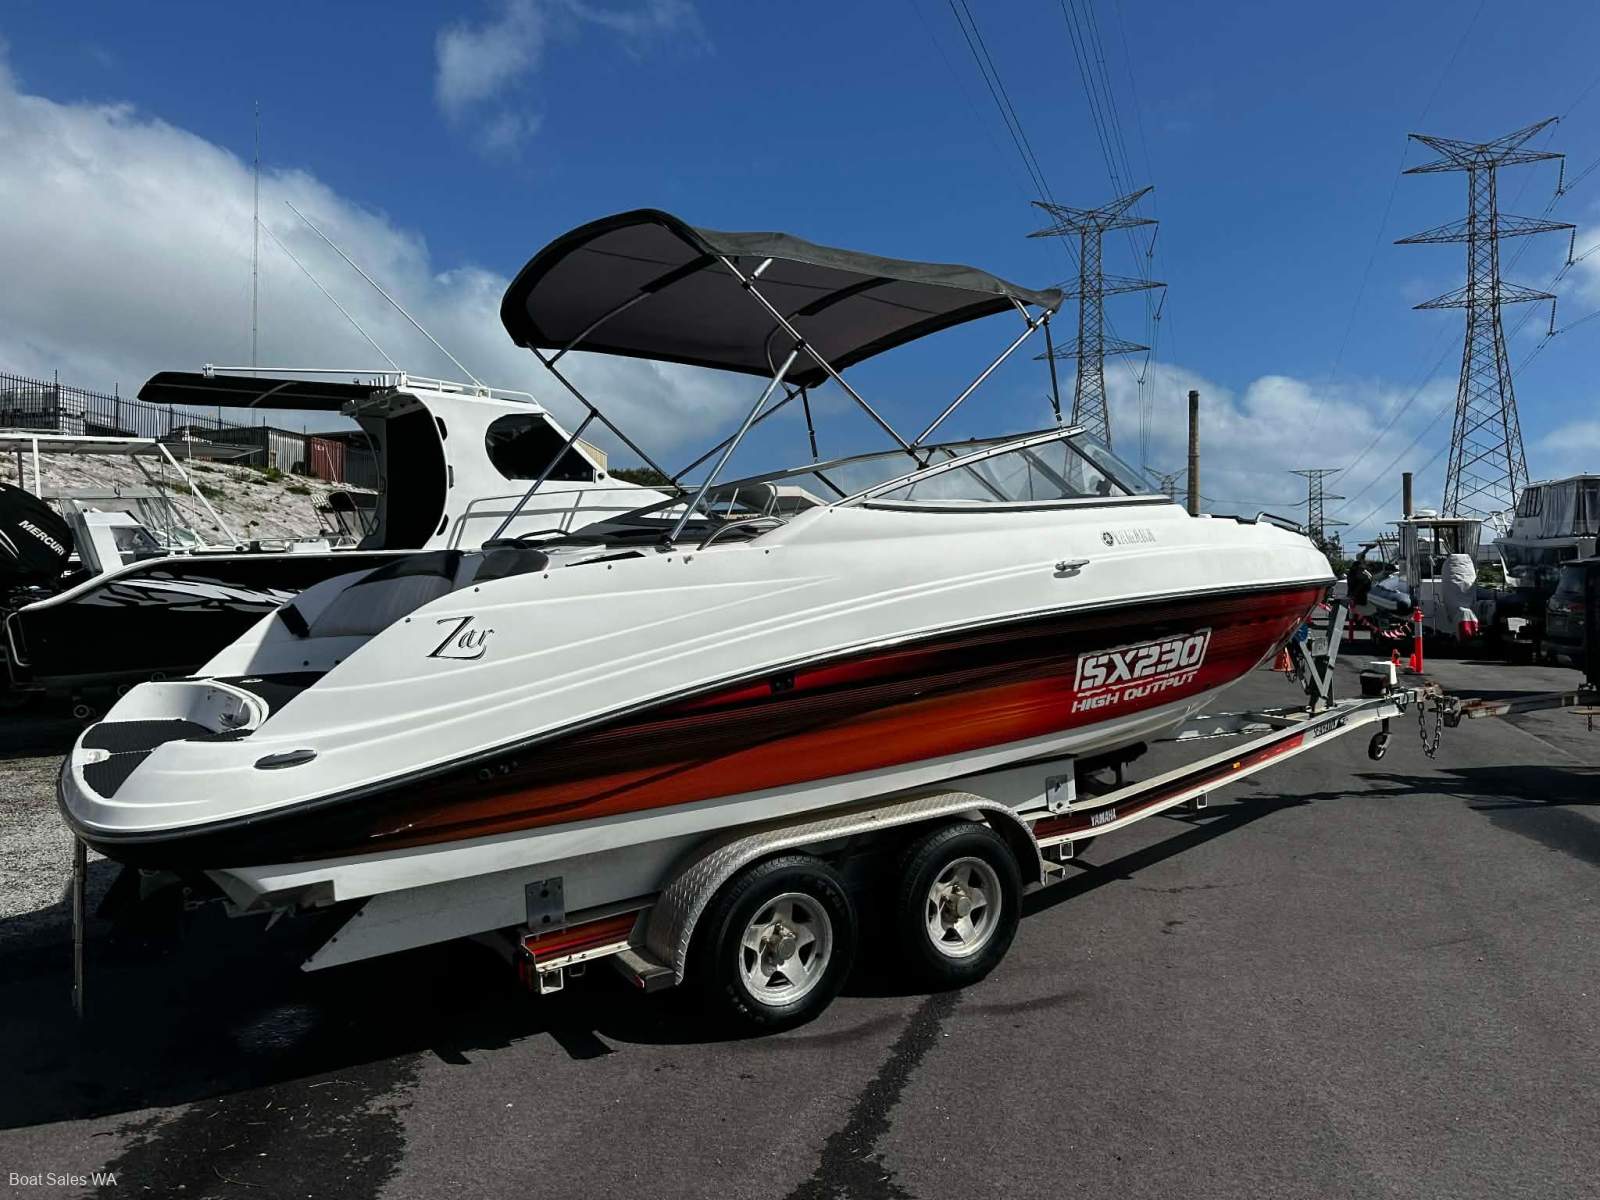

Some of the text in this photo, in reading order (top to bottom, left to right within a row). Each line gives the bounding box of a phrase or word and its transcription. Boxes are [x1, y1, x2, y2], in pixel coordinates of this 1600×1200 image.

[426, 616, 495, 660] Zar
[1081, 635, 1205, 690] SX230
[1072, 671, 1198, 714] HIGH OUTPUT
[1091, 807, 1117, 827] YAMAHA
